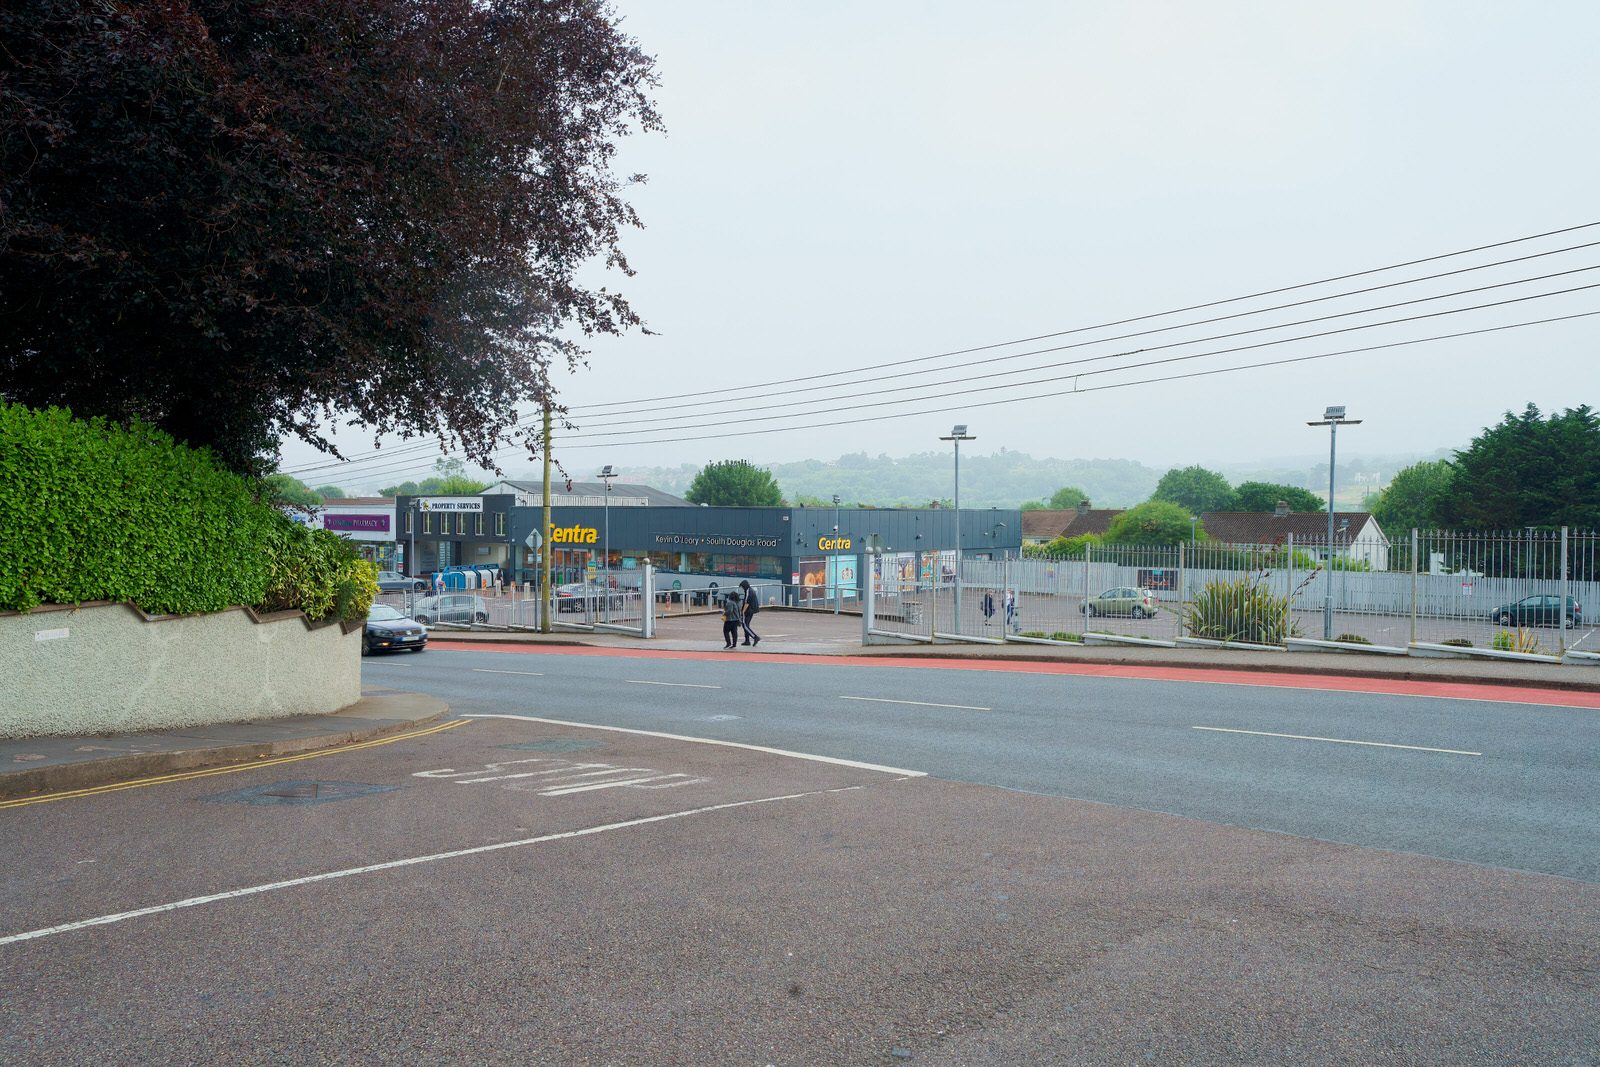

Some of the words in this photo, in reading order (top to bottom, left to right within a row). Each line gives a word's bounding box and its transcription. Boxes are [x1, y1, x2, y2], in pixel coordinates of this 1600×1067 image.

[353, 519, 377, 527] PHARMACY
[655, 535, 673, 543] Kevin
[674, 535, 699, 546] O'Leary
[706, 537, 726, 546] South
[727, 537, 755, 548] Douglas
[757, 538, 777, 547] Road
[818, 537, 851, 550] Centra
[412, 758, 710, 796] STOP
